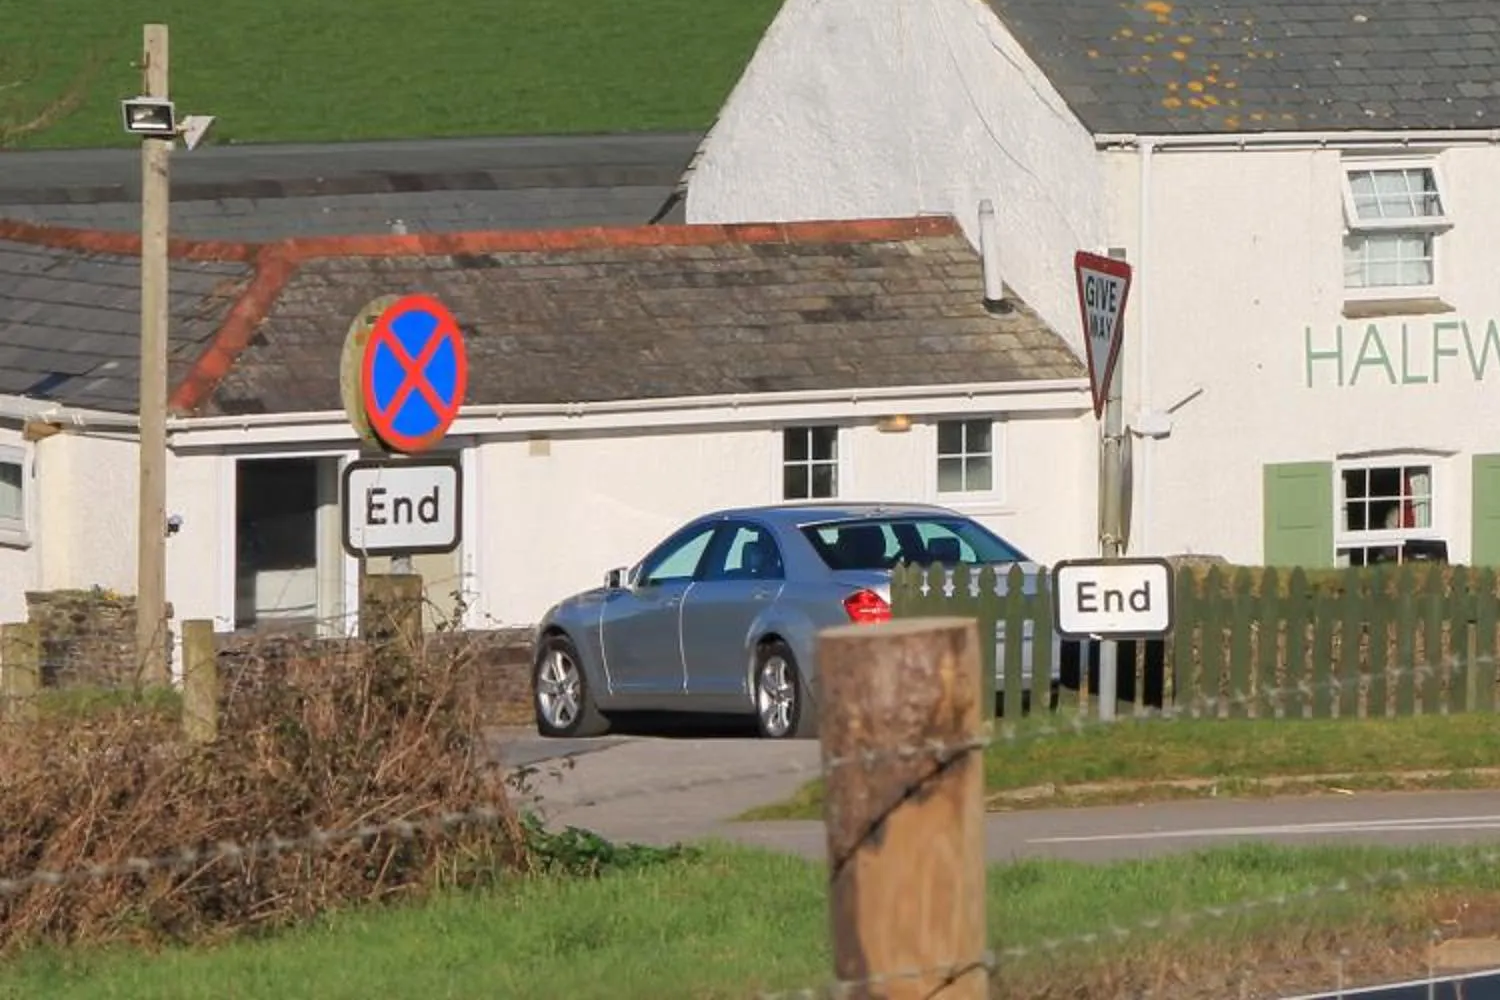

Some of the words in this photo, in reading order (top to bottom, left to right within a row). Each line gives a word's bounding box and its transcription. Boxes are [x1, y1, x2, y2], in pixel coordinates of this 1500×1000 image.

[1085, 275, 1117, 313] GIVE
[1089, 313, 1113, 341] WAY
[366, 485, 440, 525] End
[1076, 580, 1151, 613] End
